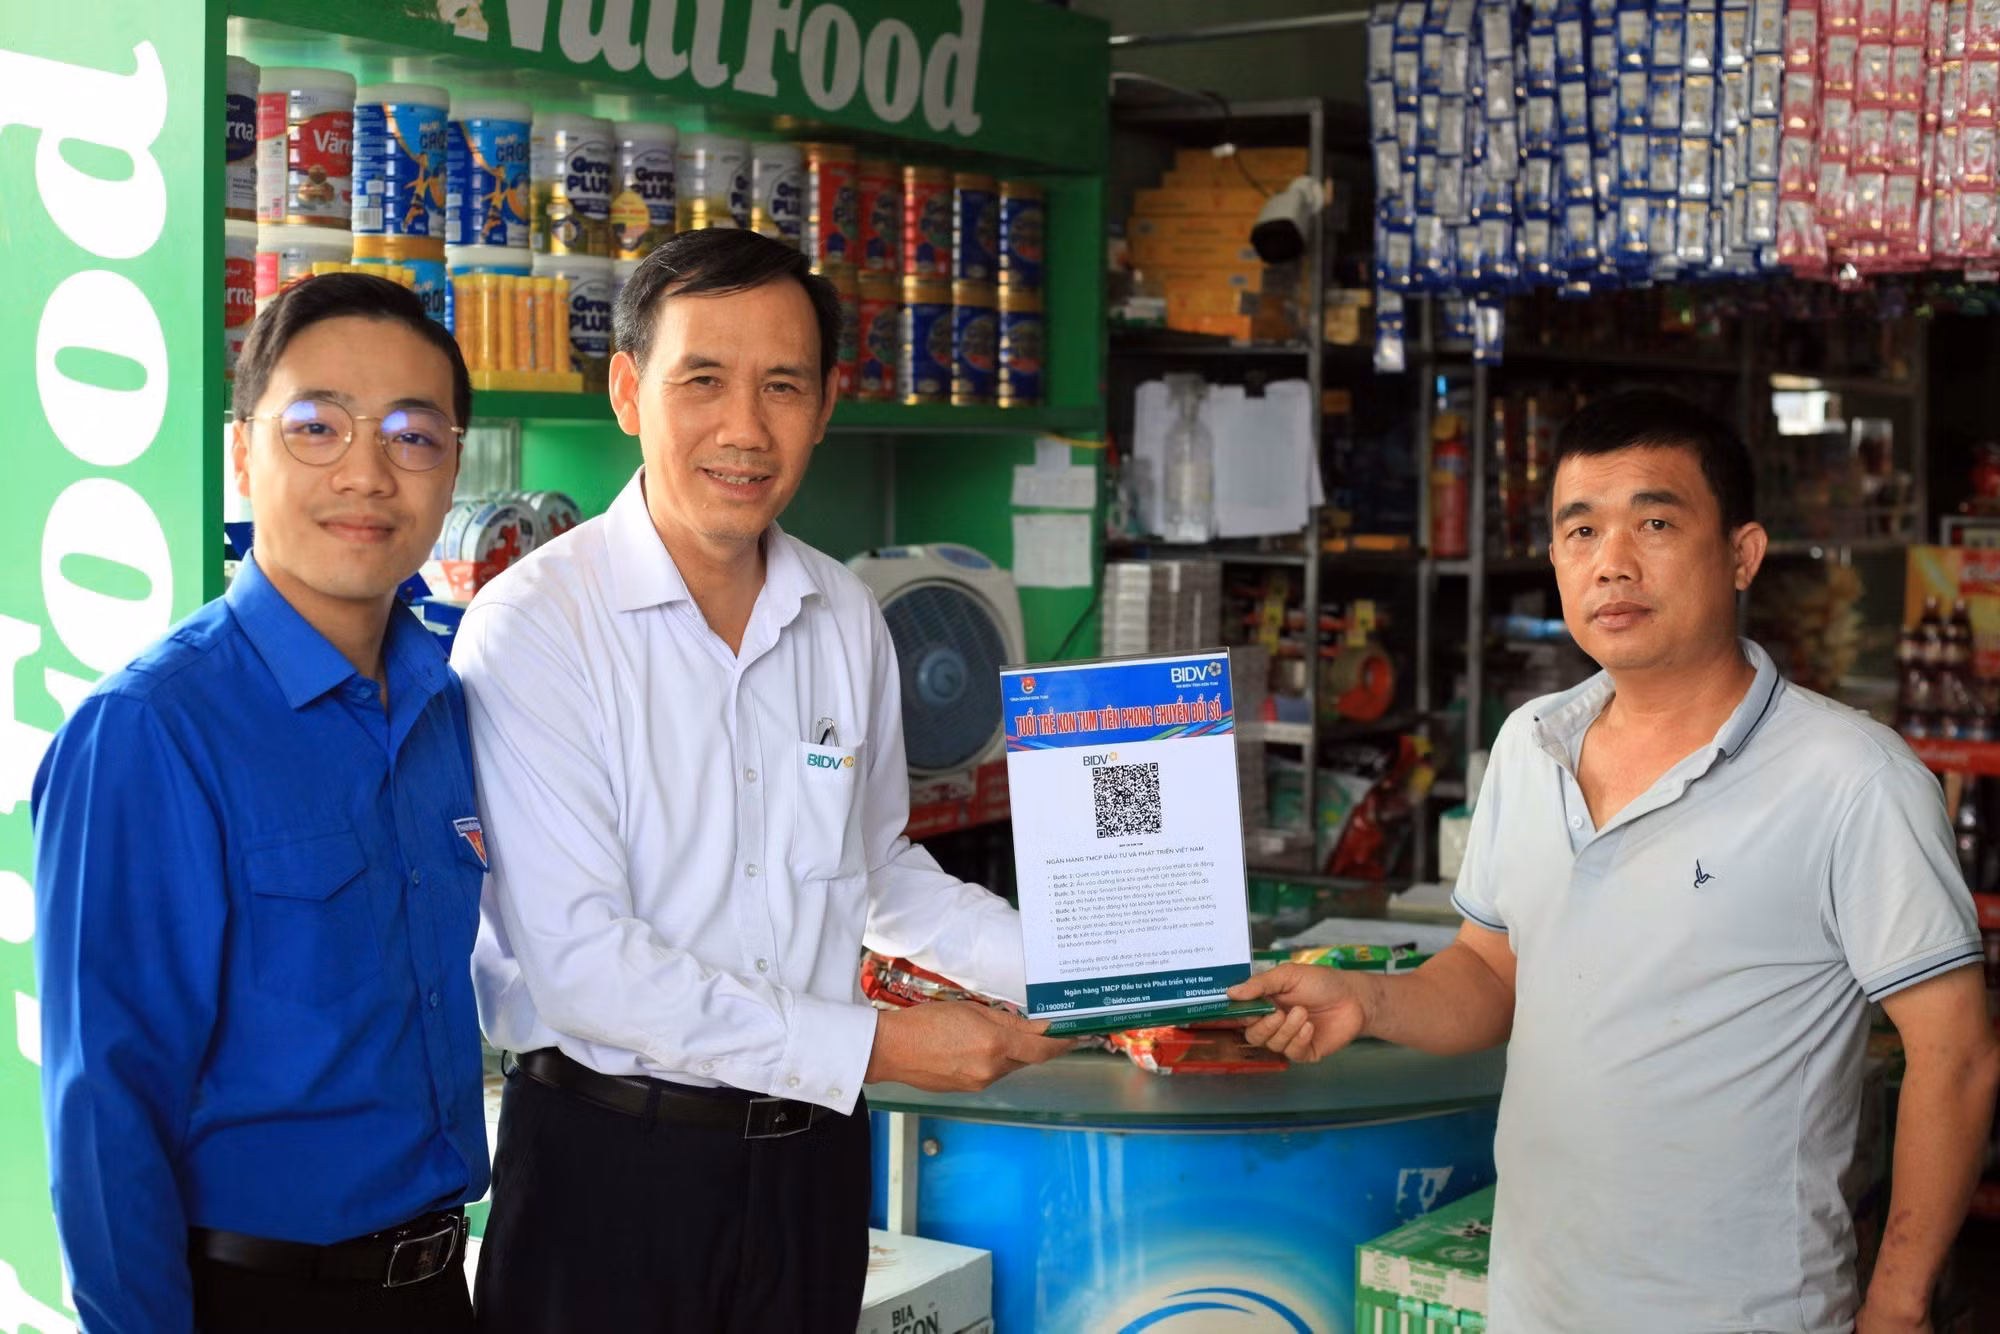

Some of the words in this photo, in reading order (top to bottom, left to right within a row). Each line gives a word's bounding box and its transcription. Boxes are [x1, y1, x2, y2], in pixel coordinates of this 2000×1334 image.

[1171, 665, 1208, 684] BIDV
[1015, 708, 1036, 737] TUỔI
[1037, 707, 1056, 735] TRẺ
[1057, 712, 1076, 733] KON
[1077, 710, 1098, 732] TUM
[1099, 706, 1120, 730] TIÊN
[1122, 706, 1153, 728] PHONG
[1154, 695, 1190, 726] CHUYỂN
[1191, 694, 1208, 722] ĐỔI
[1208, 693, 1222, 721] SỐ
[807, 753, 844, 770] BIDV
[1083, 754, 1108, 767] BIDV
[1063, 989, 1082, 997] Ngân
[1082, 987, 1100, 996] hàng
[1112, 994, 1150, 1004] bidv.com.vn
[1046, 1002, 1076, 1011] 19009247
[892, 1304, 916, 1328] BIA
